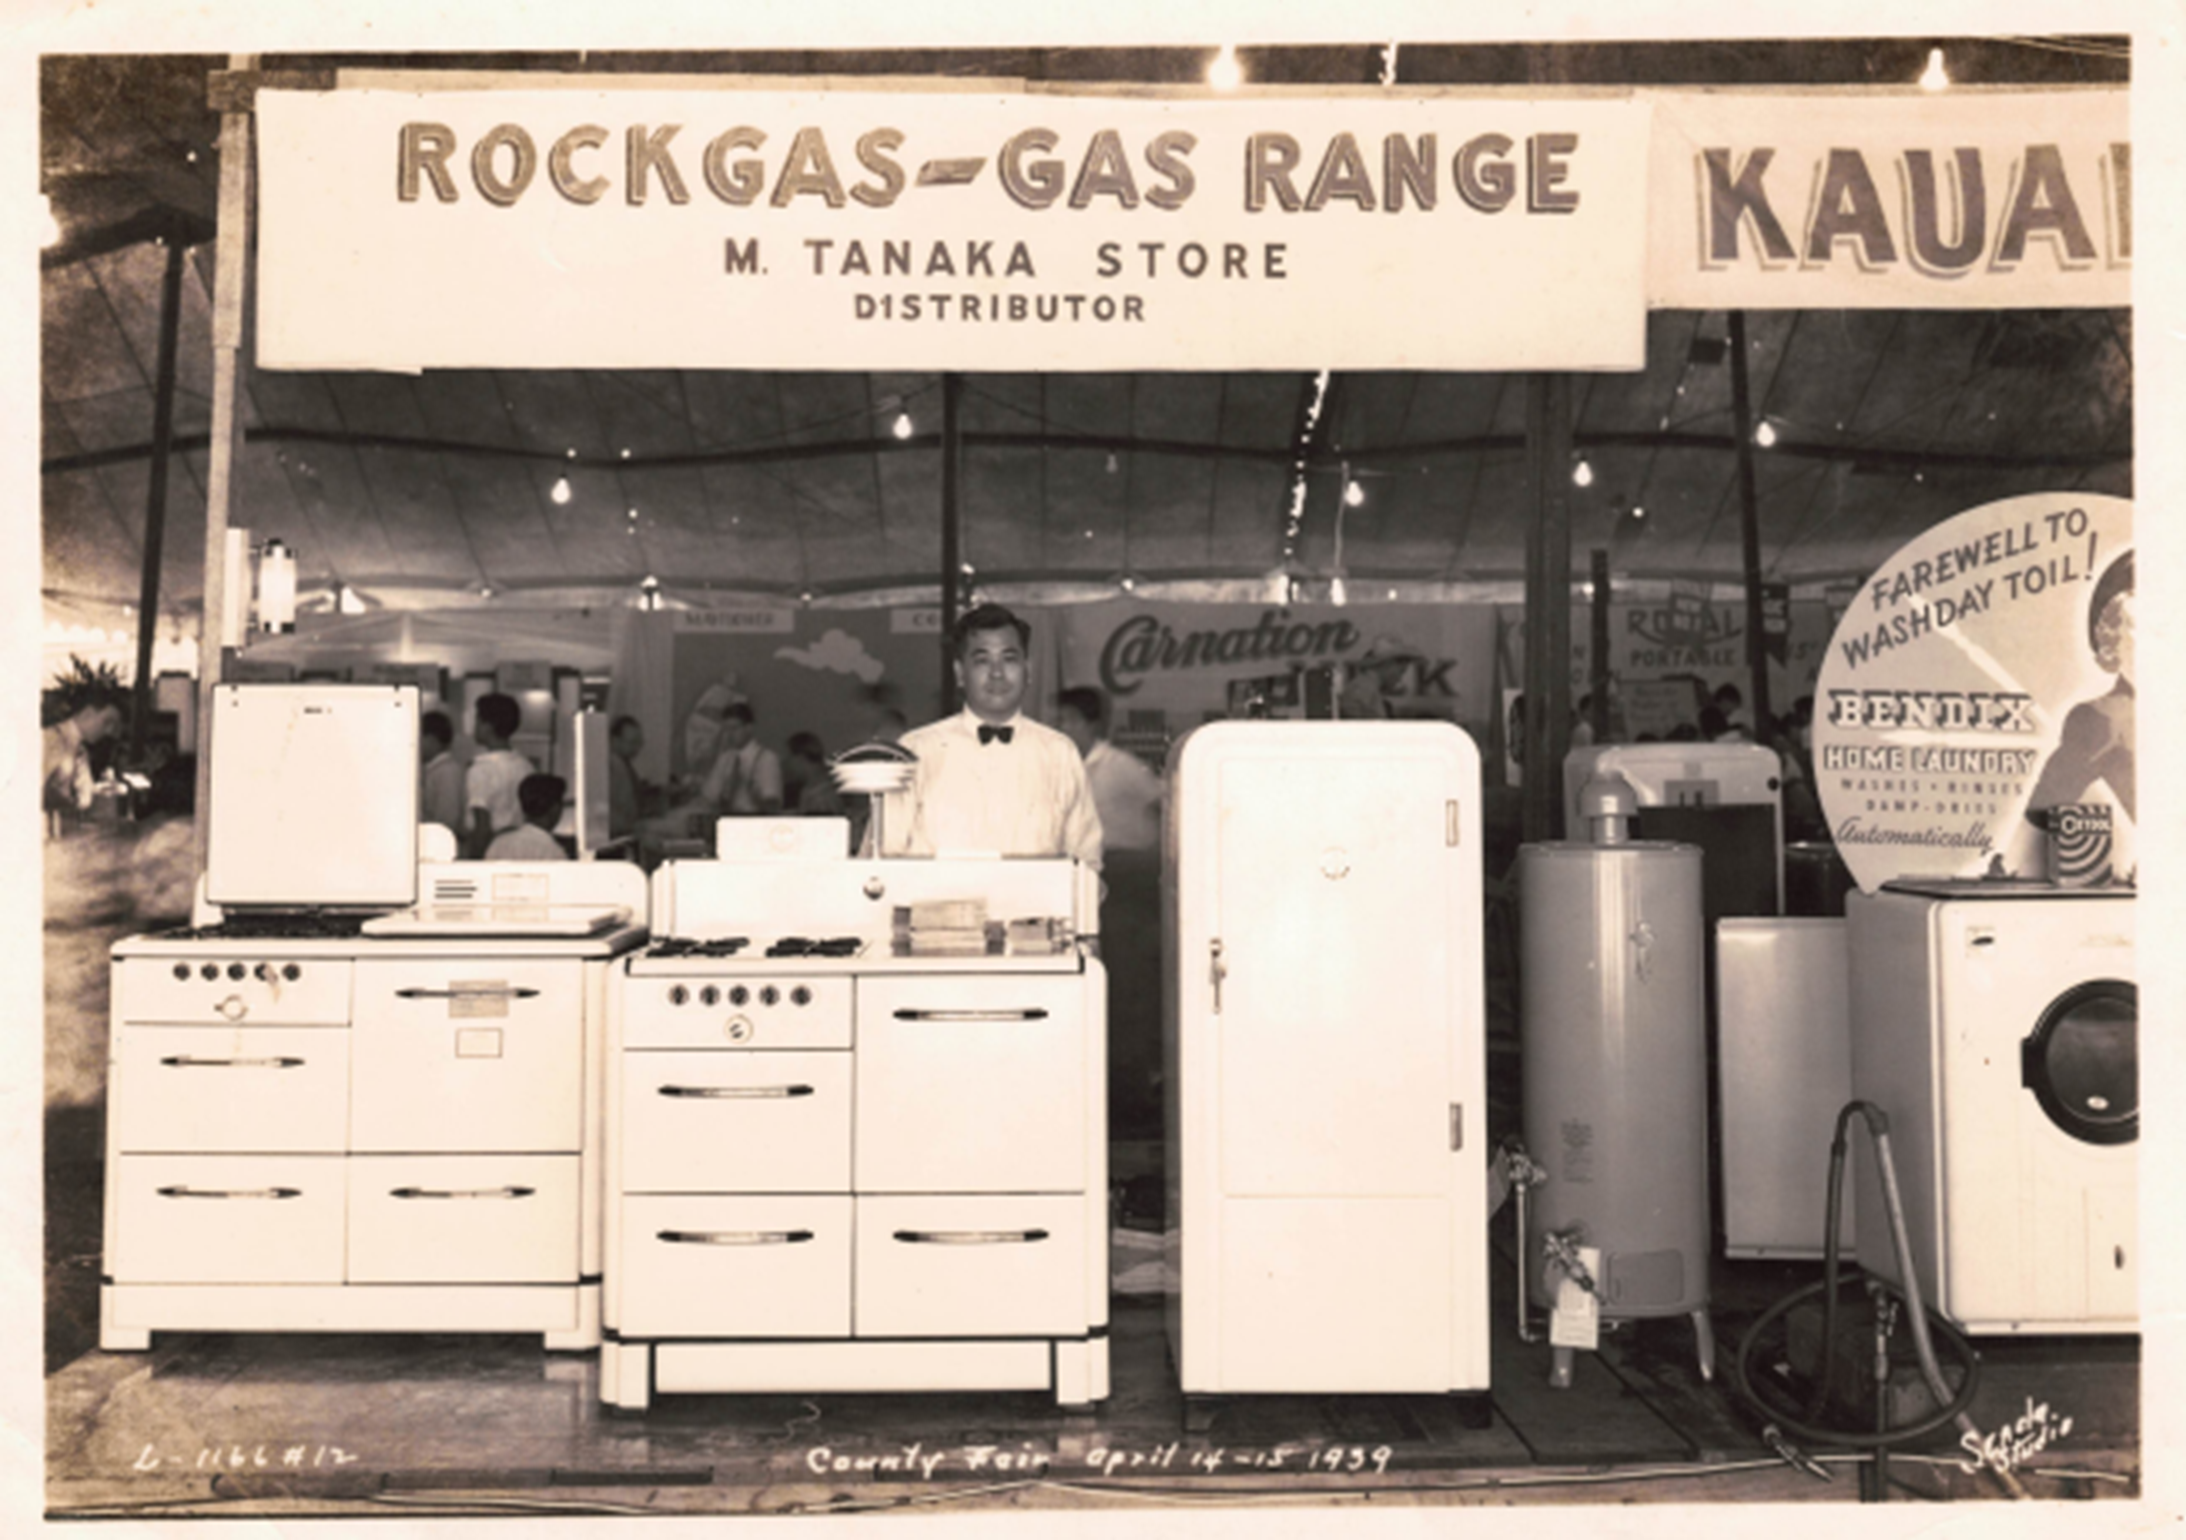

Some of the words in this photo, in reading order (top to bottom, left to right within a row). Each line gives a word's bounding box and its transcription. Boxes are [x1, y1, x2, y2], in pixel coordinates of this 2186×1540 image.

[1245, 133, 1581, 216] RANGE
[725, 238, 768, 276] M.
[804, 239, 1036, 278] TANAKA
[1098, 242, 1289, 280] STORE
[854, 293, 1146, 324] DISTRIBUTOR
[1871, 522, 2039, 611] FAREWELL
[2044, 507, 2088, 542] TO
[1842, 578, 1994, 669] WASHDAY
[2004, 530, 2097, 600] TOIL!
[1099, 611, 1359, 696] Carnation
[1828, 689, 2034, 732] BENDIX
[1823, 745, 1903, 771] HOME
[1911, 748, 2037, 774] LAUNDRY
[1836, 815, 1993, 856] Automatically
